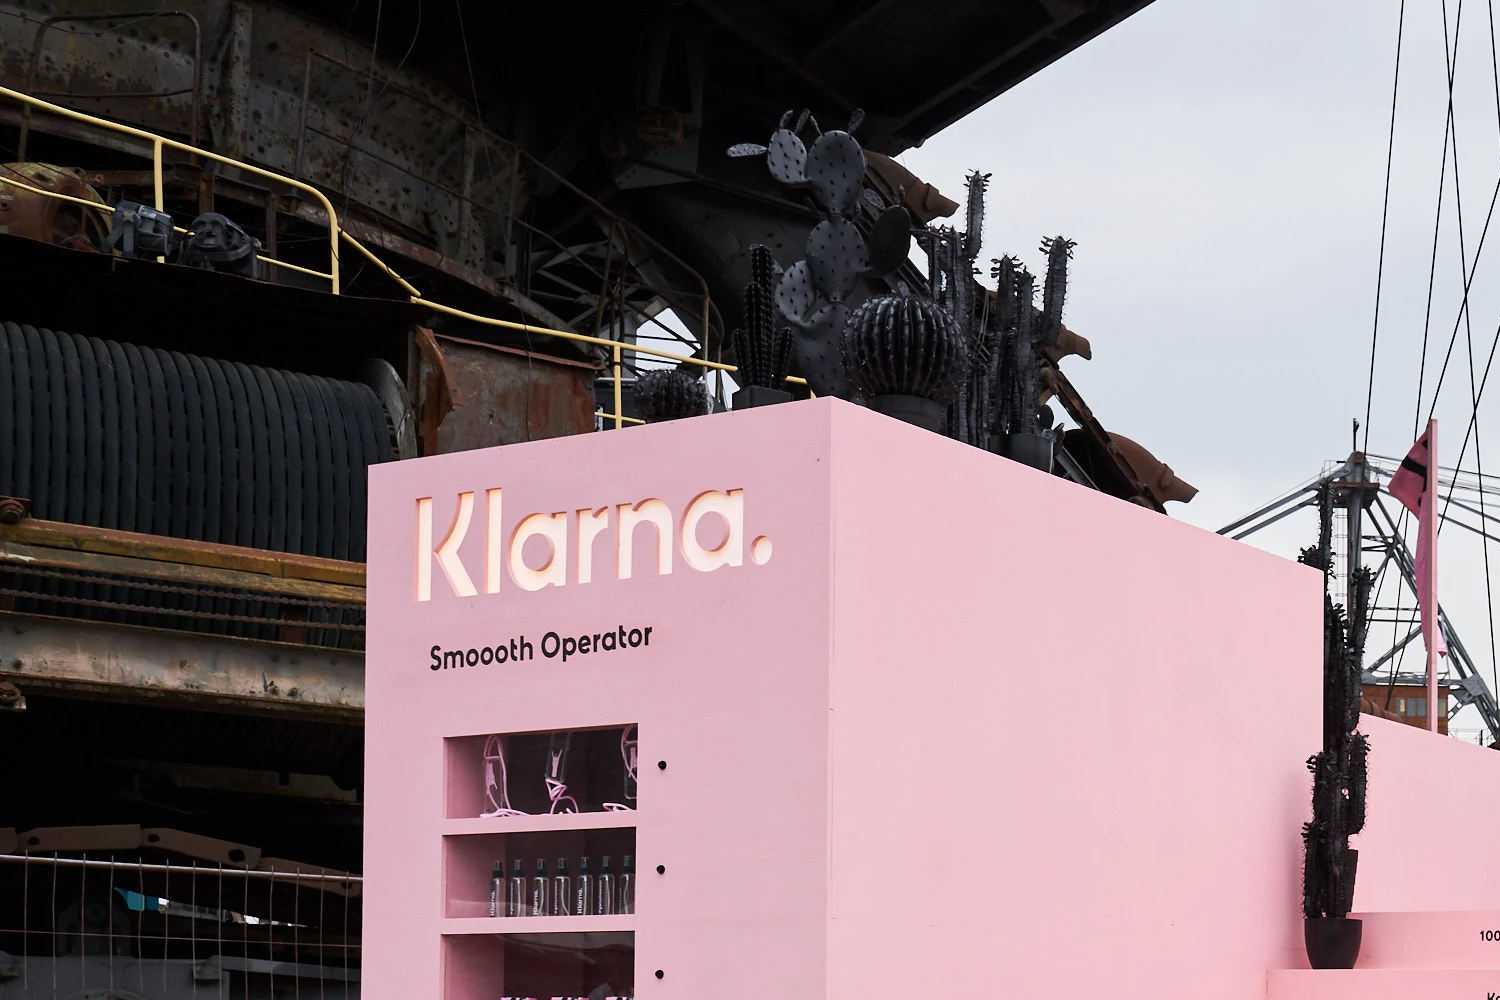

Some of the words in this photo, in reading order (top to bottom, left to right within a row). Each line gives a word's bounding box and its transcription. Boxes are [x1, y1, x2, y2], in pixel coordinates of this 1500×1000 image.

[415, 487, 773, 602] Klarna.
[430, 635, 534, 672] Smoooth
[540, 625, 653, 663] Operator
